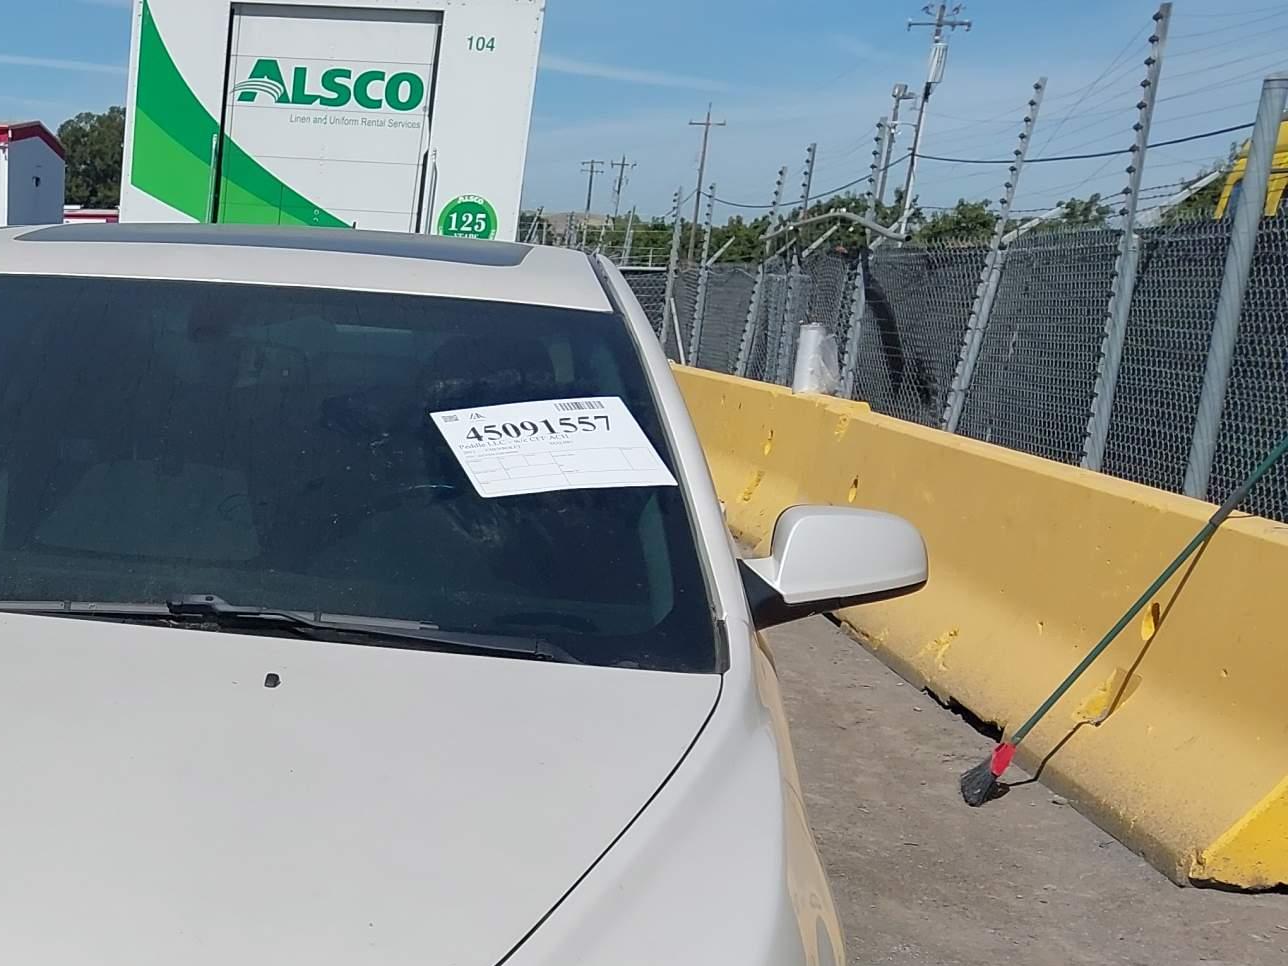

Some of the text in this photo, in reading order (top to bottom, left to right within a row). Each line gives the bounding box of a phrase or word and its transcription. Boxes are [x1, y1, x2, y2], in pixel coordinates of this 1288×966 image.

[467, 36, 496, 52] 104
[234, 59, 424, 111] ALSCO
[289, 114, 421, 129] Linen and Uniform Rental Services
[448, 212, 486, 232] 125
[466, 415, 611, 442] 45091557
